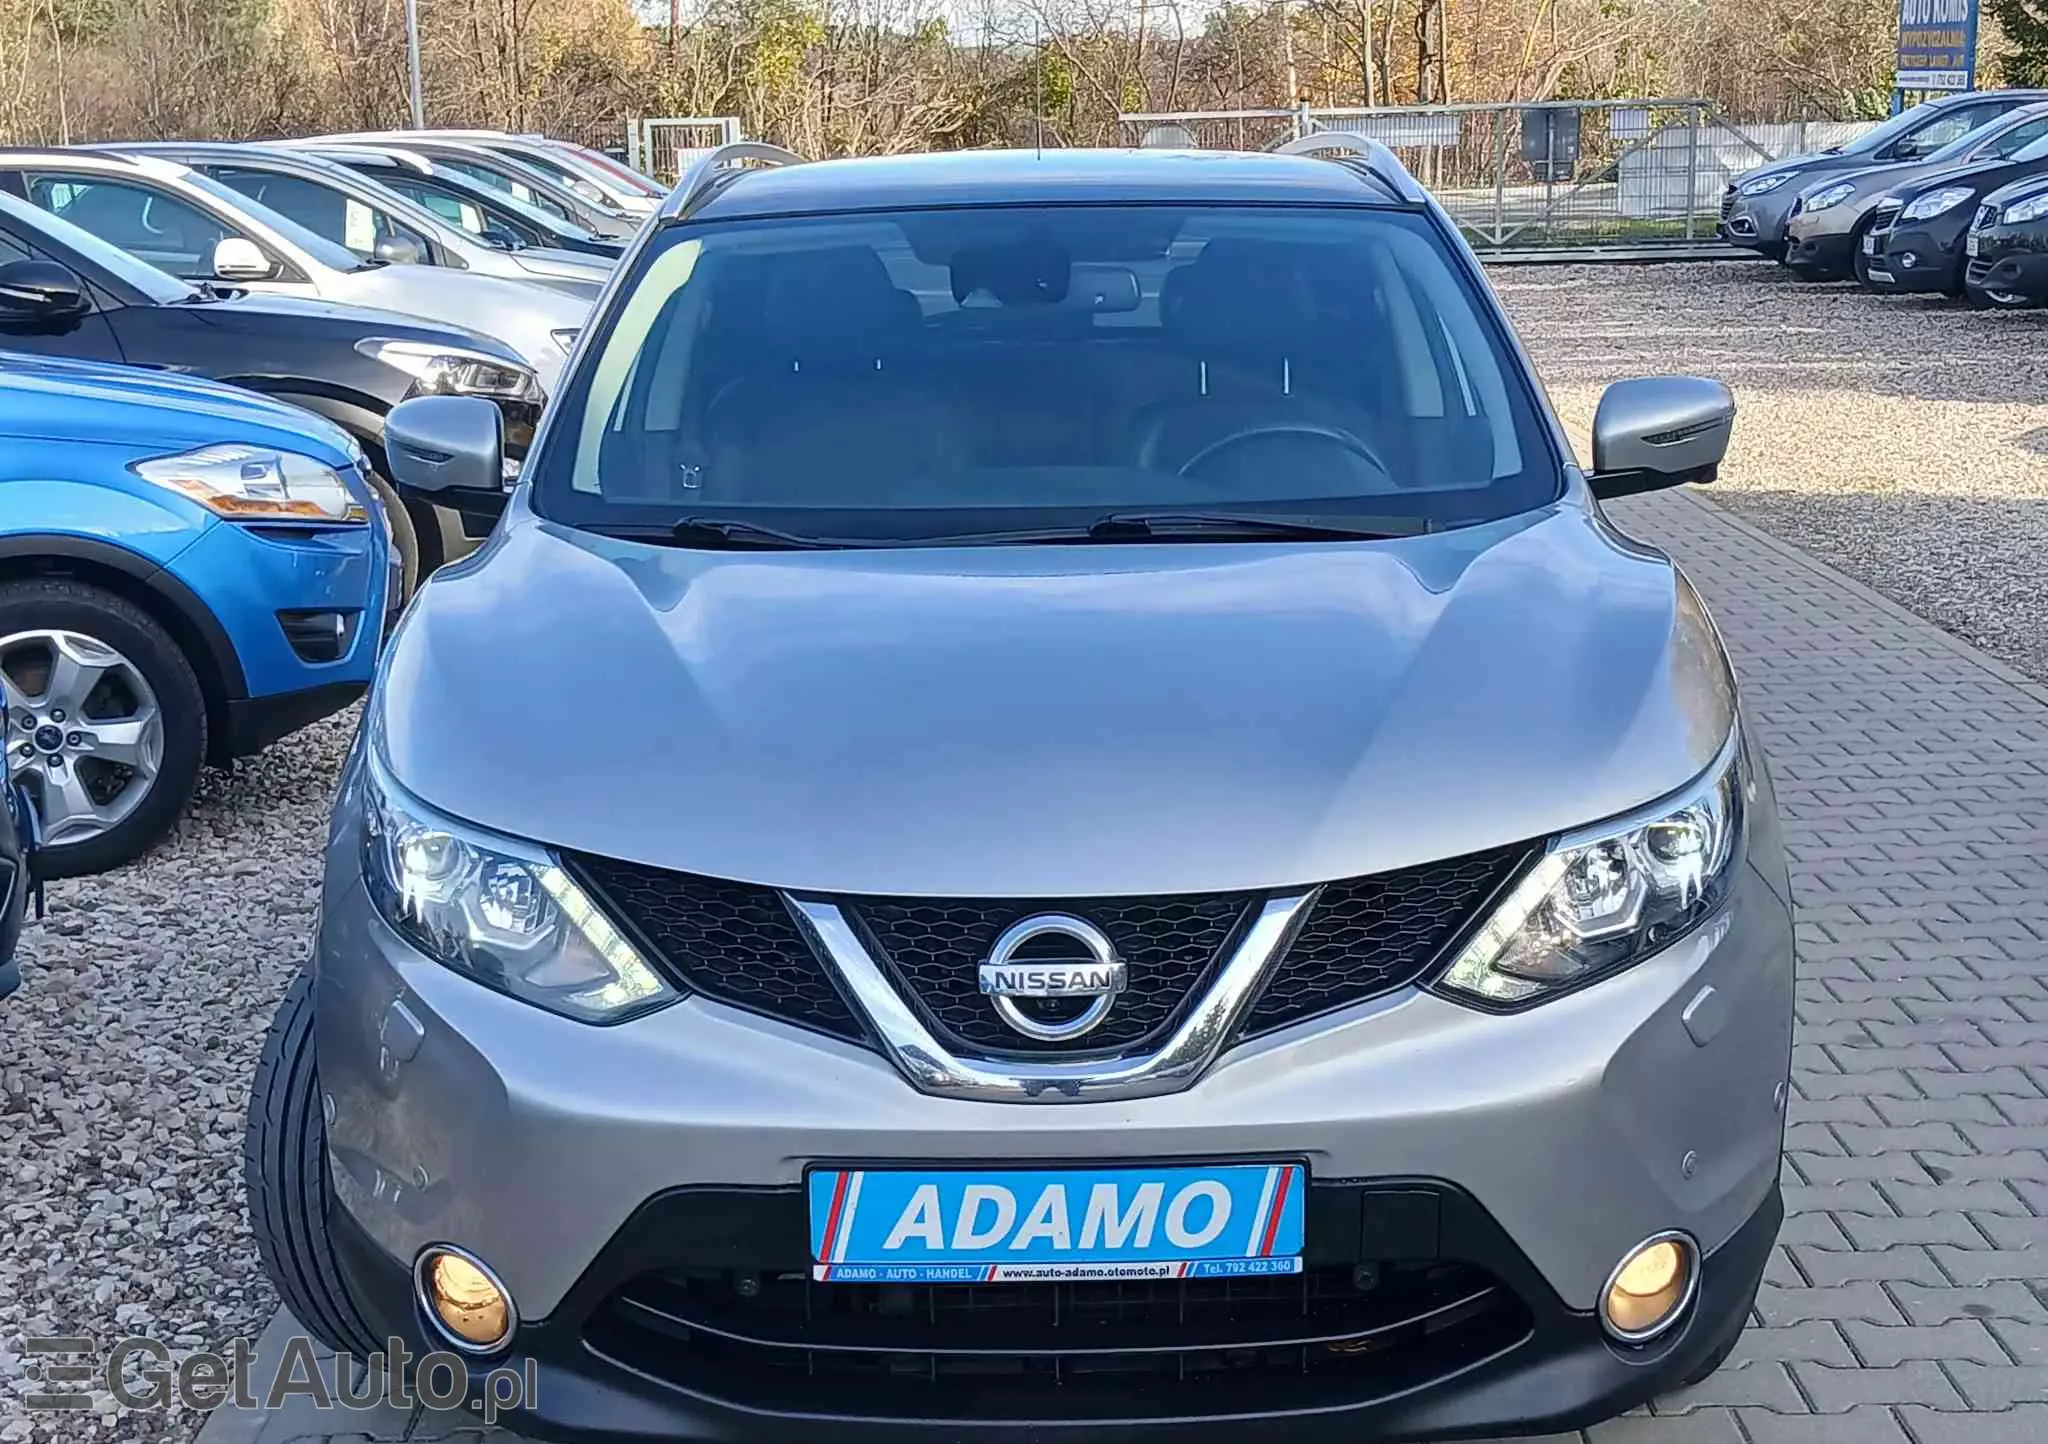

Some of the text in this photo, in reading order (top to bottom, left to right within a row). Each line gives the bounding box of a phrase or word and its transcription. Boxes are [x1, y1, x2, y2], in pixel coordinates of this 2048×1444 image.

[995, 971, 1110, 990] NISSAN
[882, 1180, 1232, 1250] ADAMO
[836, 1268, 877, 1279] ADAMO
[886, 1268, 918, 1279] AUTO
[926, 1268, 972, 1279] HANDEL
[1002, 1265, 1170, 1279] www.auto-adamo.otomoto.pl
[1204, 1264, 1223, 1274] Tel.
[1247, 1262, 1268, 1273] 422
